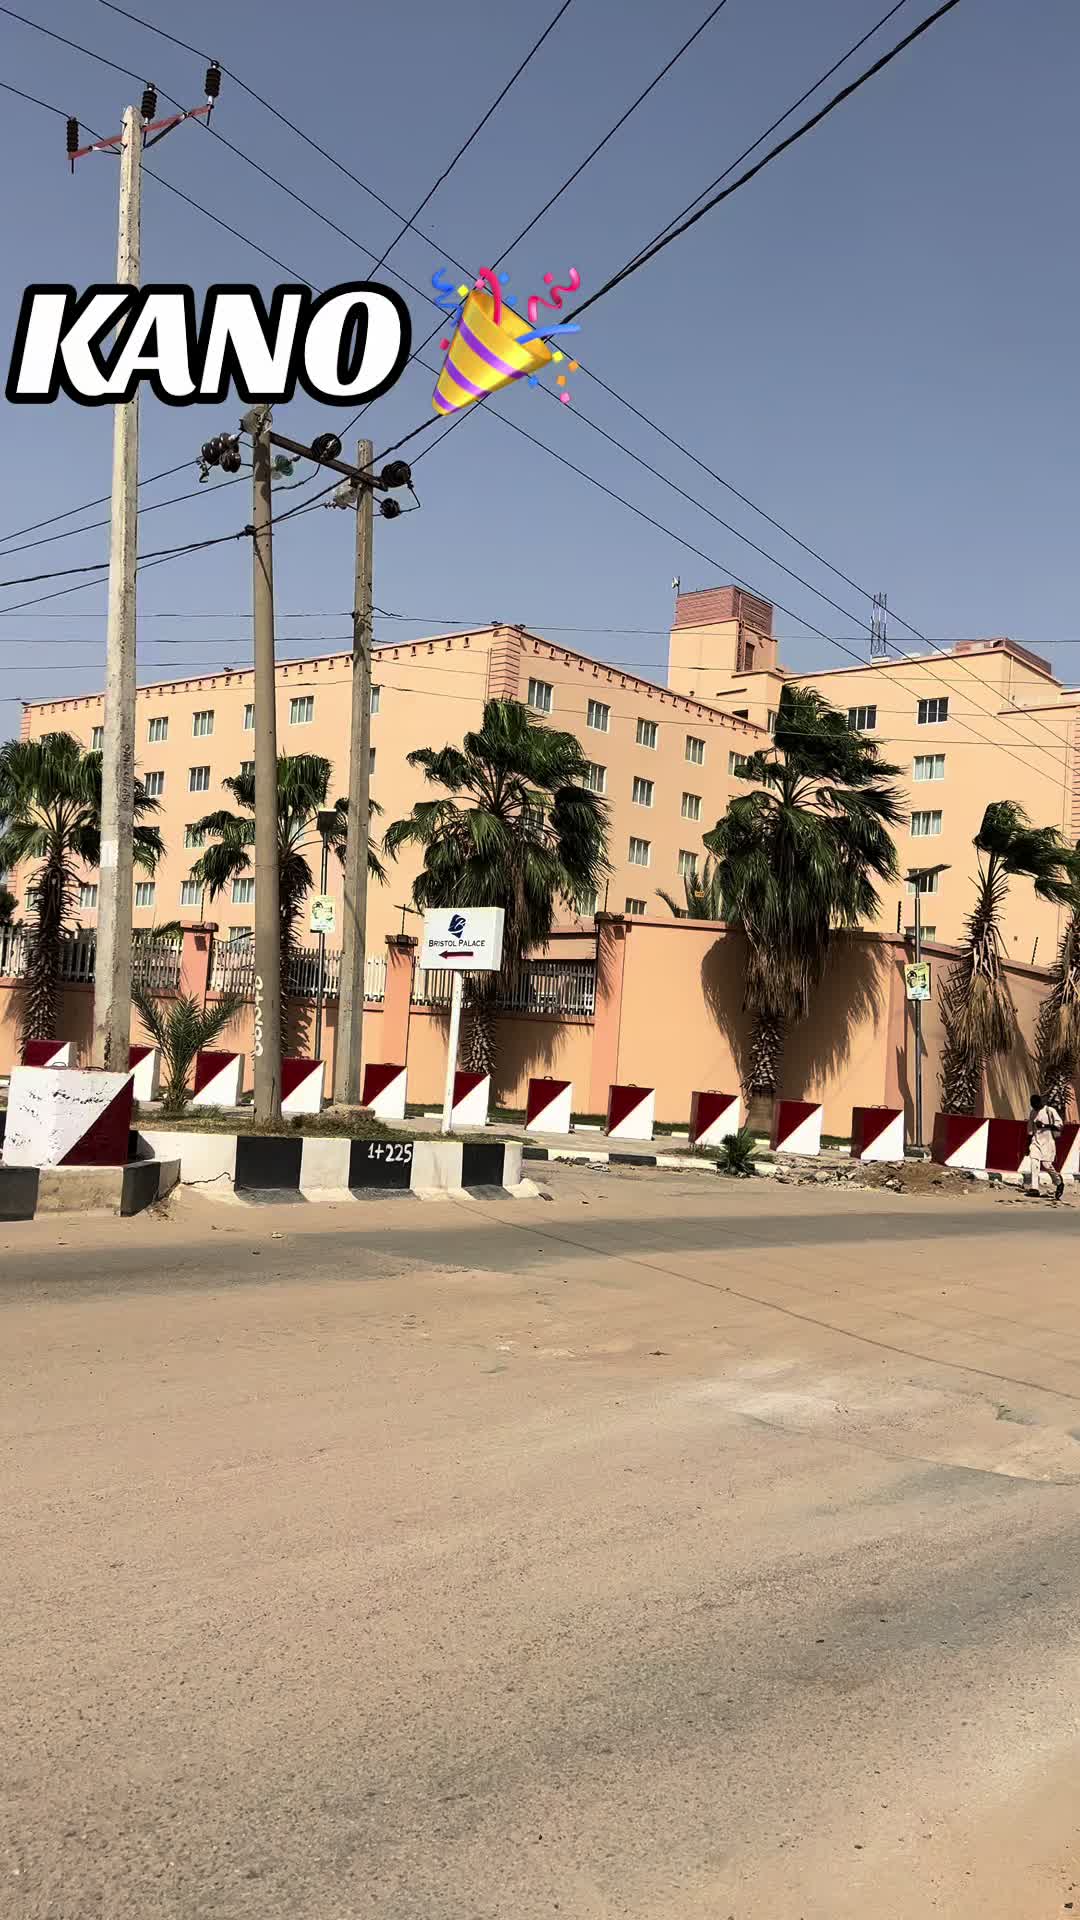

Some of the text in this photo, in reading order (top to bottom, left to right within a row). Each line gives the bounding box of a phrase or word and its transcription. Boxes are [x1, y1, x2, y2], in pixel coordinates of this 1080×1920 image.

[428, 939, 486, 947] BRISTOL PALACE
[367, 1142, 413, 1163] 1+225
